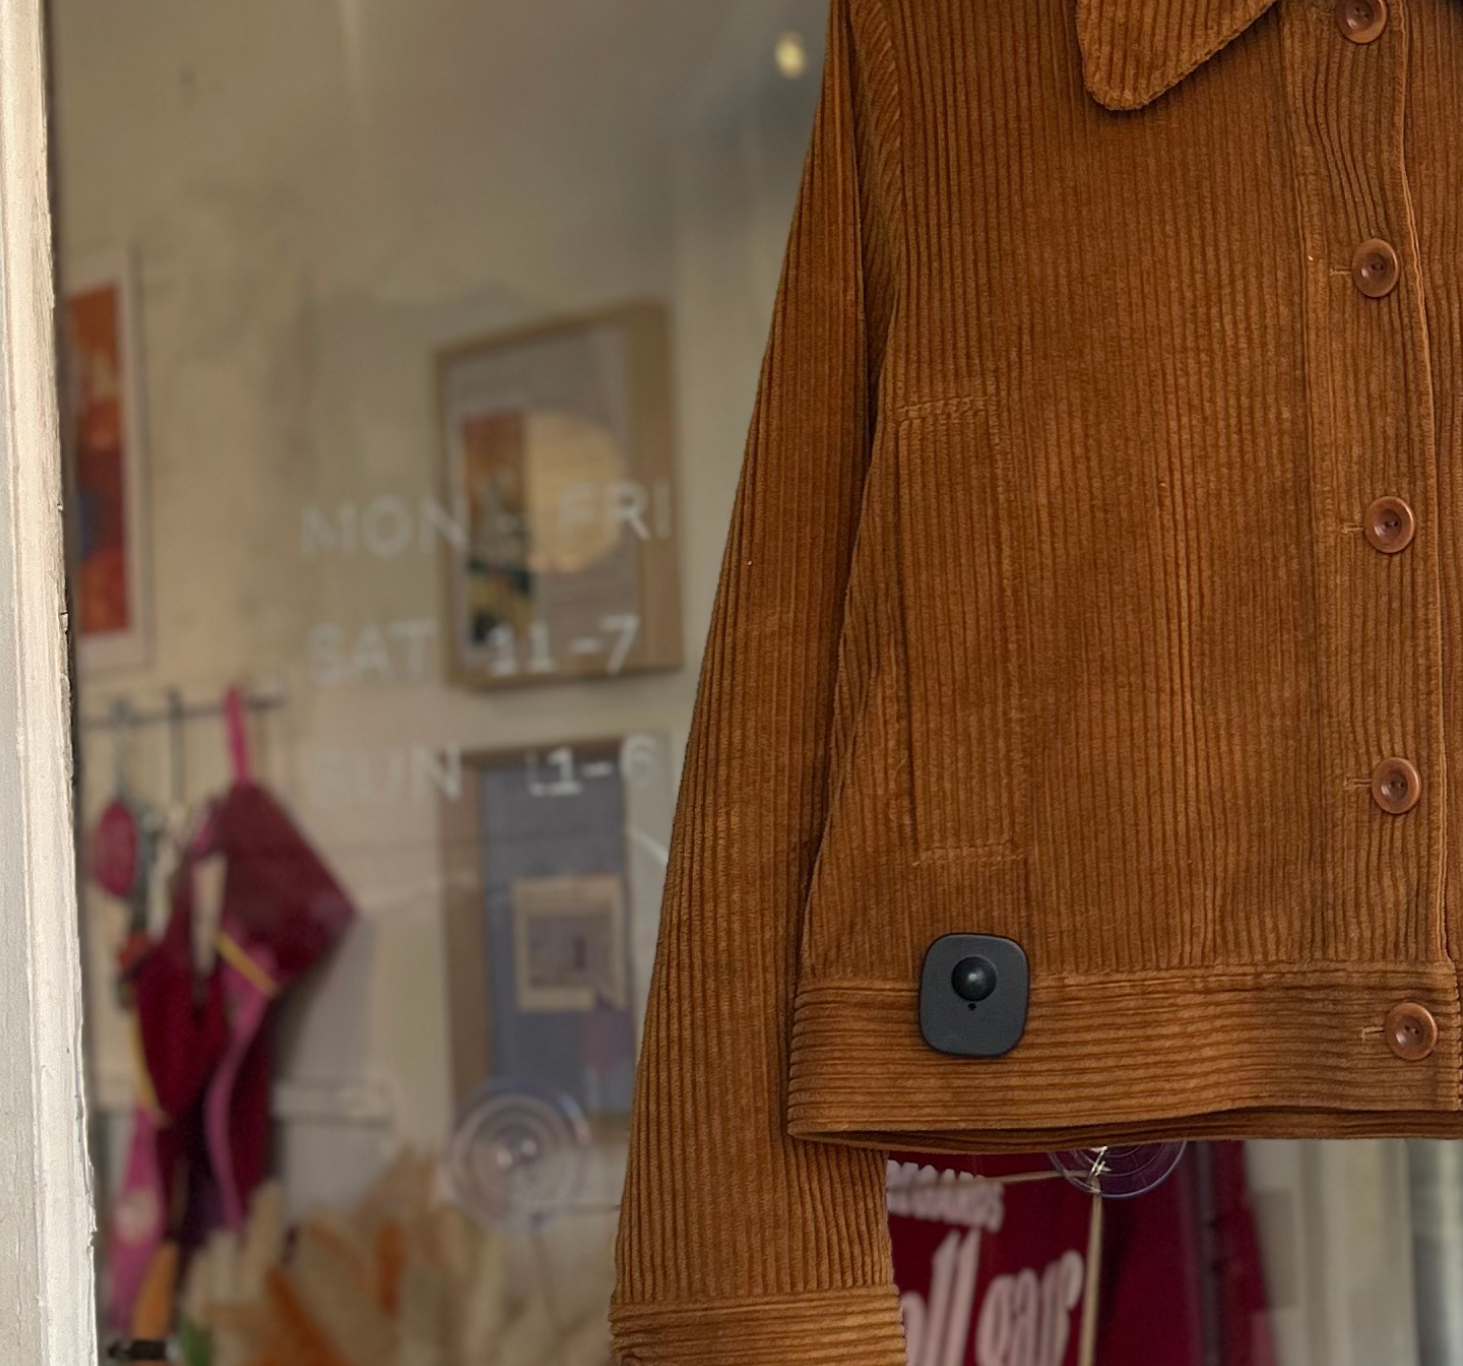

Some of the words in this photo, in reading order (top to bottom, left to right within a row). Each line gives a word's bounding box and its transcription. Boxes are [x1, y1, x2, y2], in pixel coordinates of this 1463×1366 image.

[300, 493, 468, 558] MON
[558, 478, 673, 542] FRI
[309, 619, 437, 685] SAT
[309, 739, 461, 807] SUN
